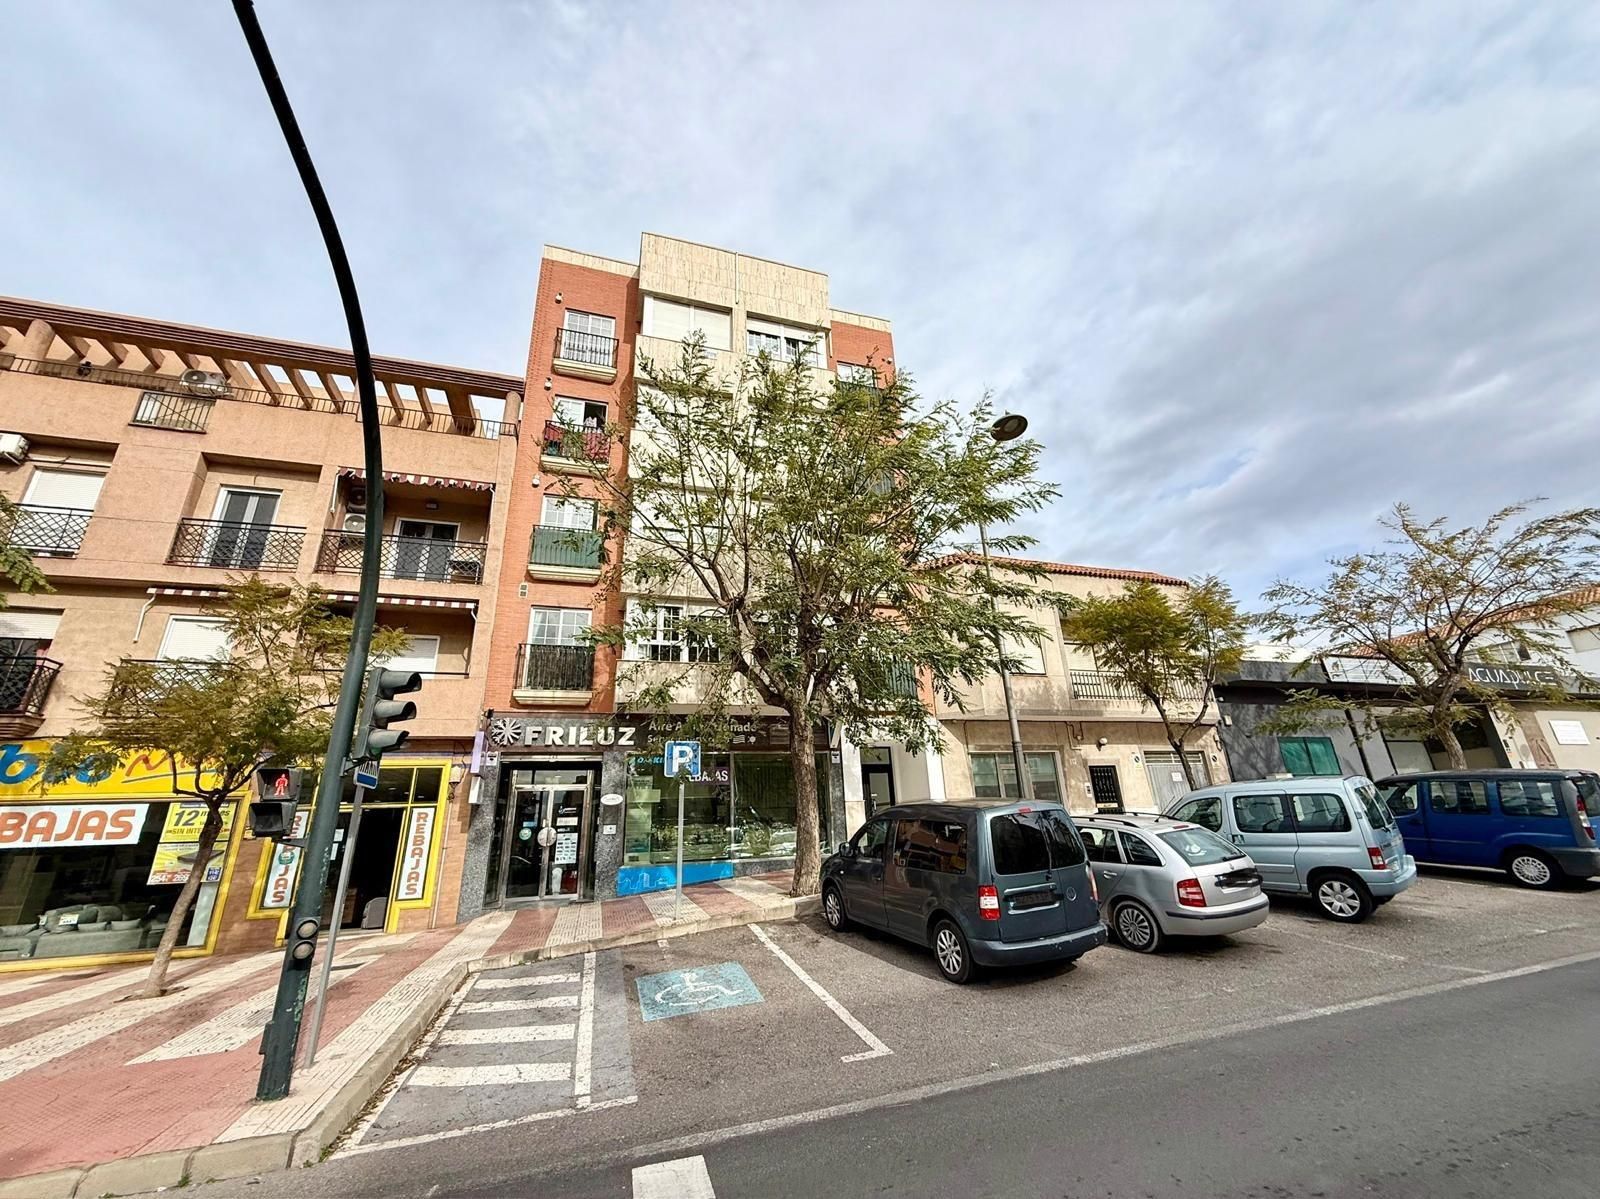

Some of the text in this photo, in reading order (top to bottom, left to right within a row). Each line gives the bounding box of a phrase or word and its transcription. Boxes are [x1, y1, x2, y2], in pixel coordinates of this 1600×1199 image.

[524, 726, 637, 746] FRILUZ
[672, 745, 694, 772] P
[173, 809, 200, 827] 12
[405, 812, 429, 896] REBAJAS
